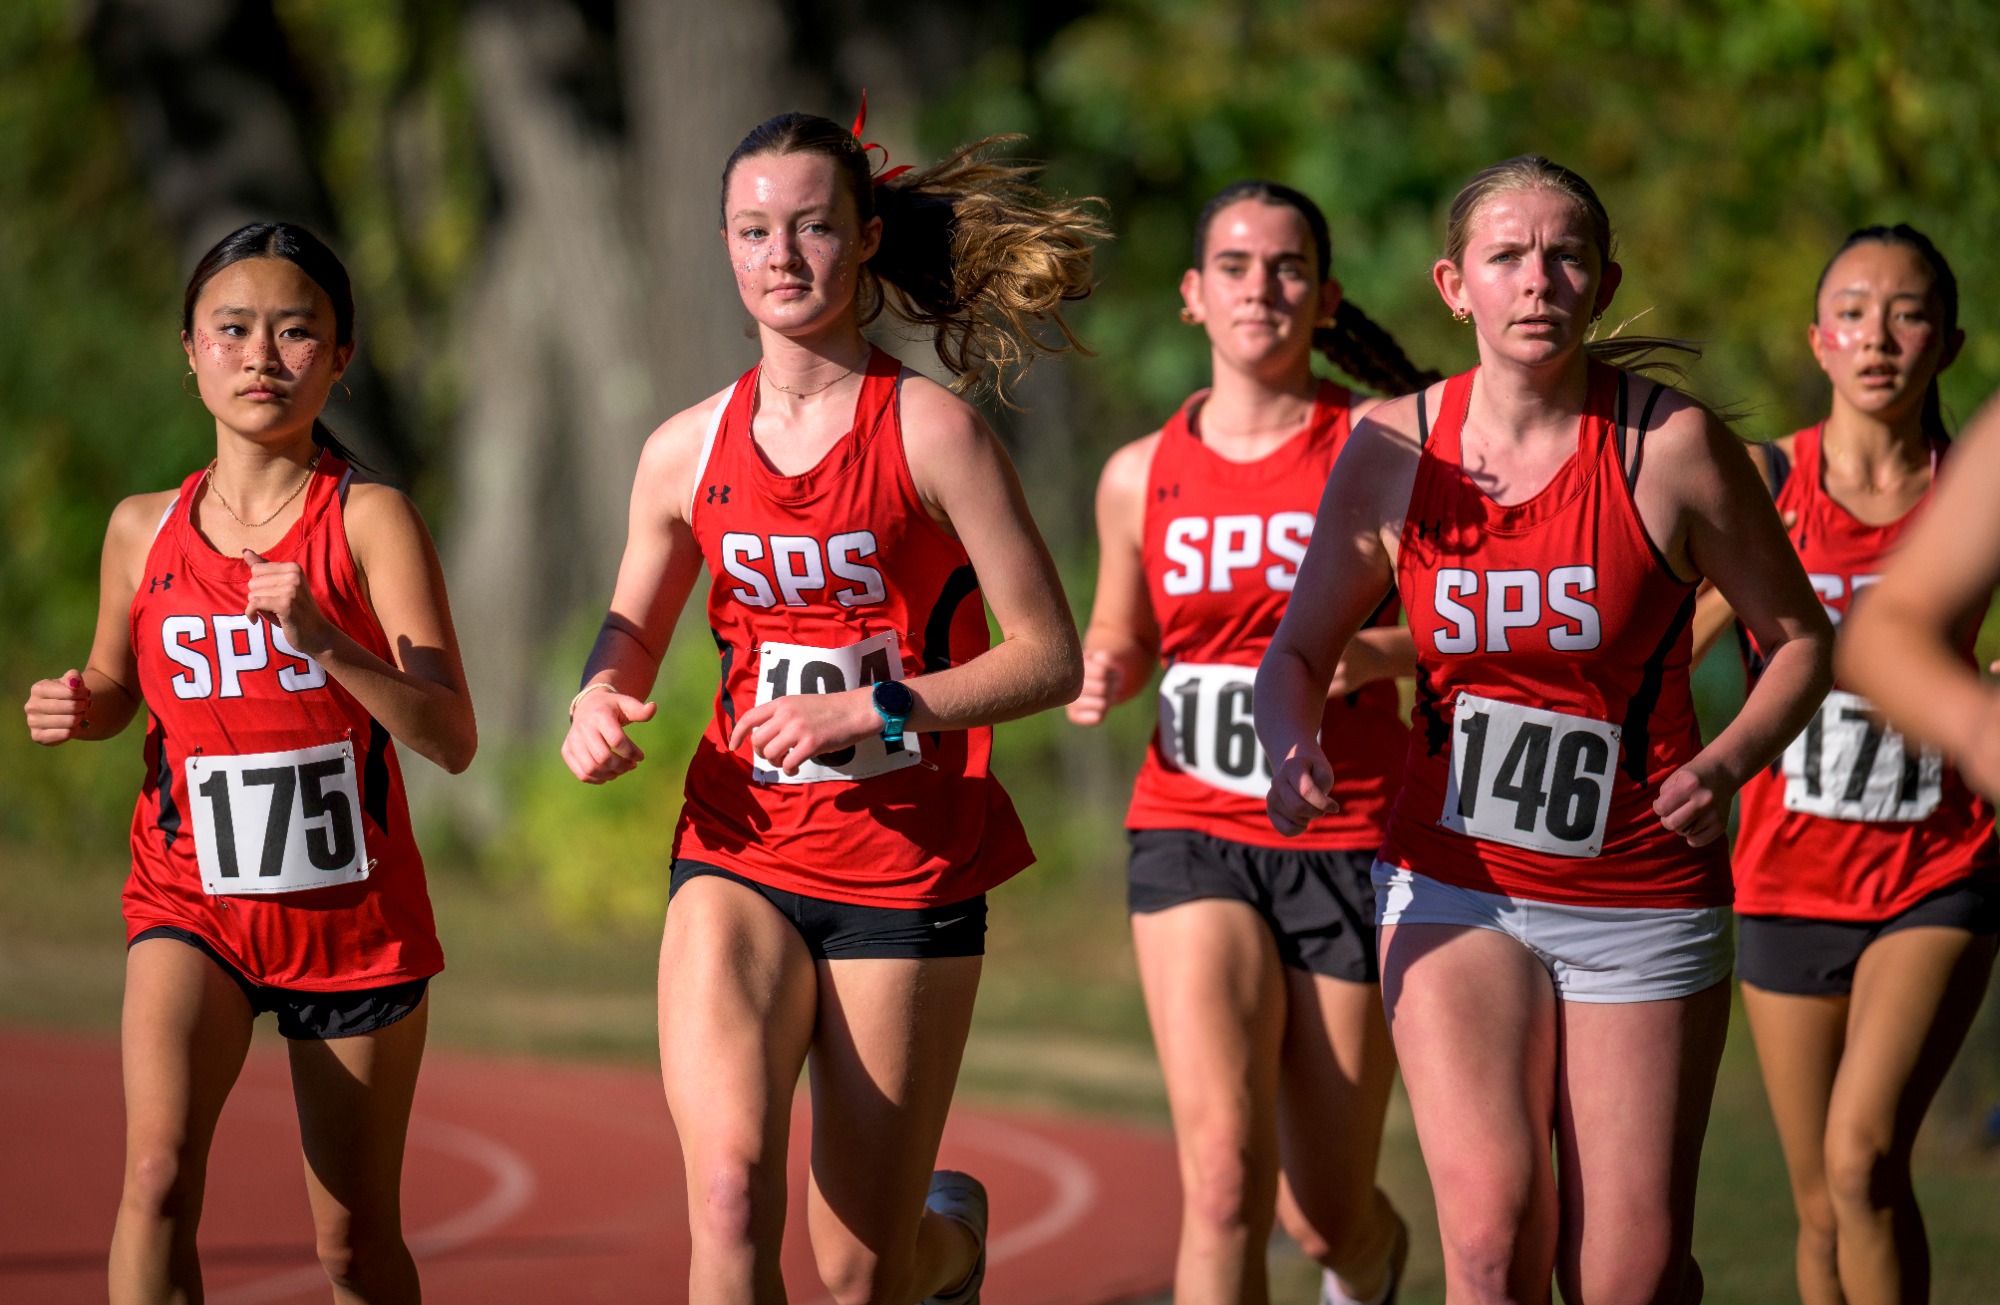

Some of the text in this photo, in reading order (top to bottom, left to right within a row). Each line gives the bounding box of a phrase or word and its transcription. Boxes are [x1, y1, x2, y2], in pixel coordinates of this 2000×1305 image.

[722, 530, 887, 607] SPS
[1163, 511, 1316, 596] SPS
[1433, 565, 1601, 653] SPS
[161, 614, 328, 700] SPS
[1174, 677, 1274, 778] 16
[199, 758, 356, 878] 175
[1457, 711, 1609, 842] 146
